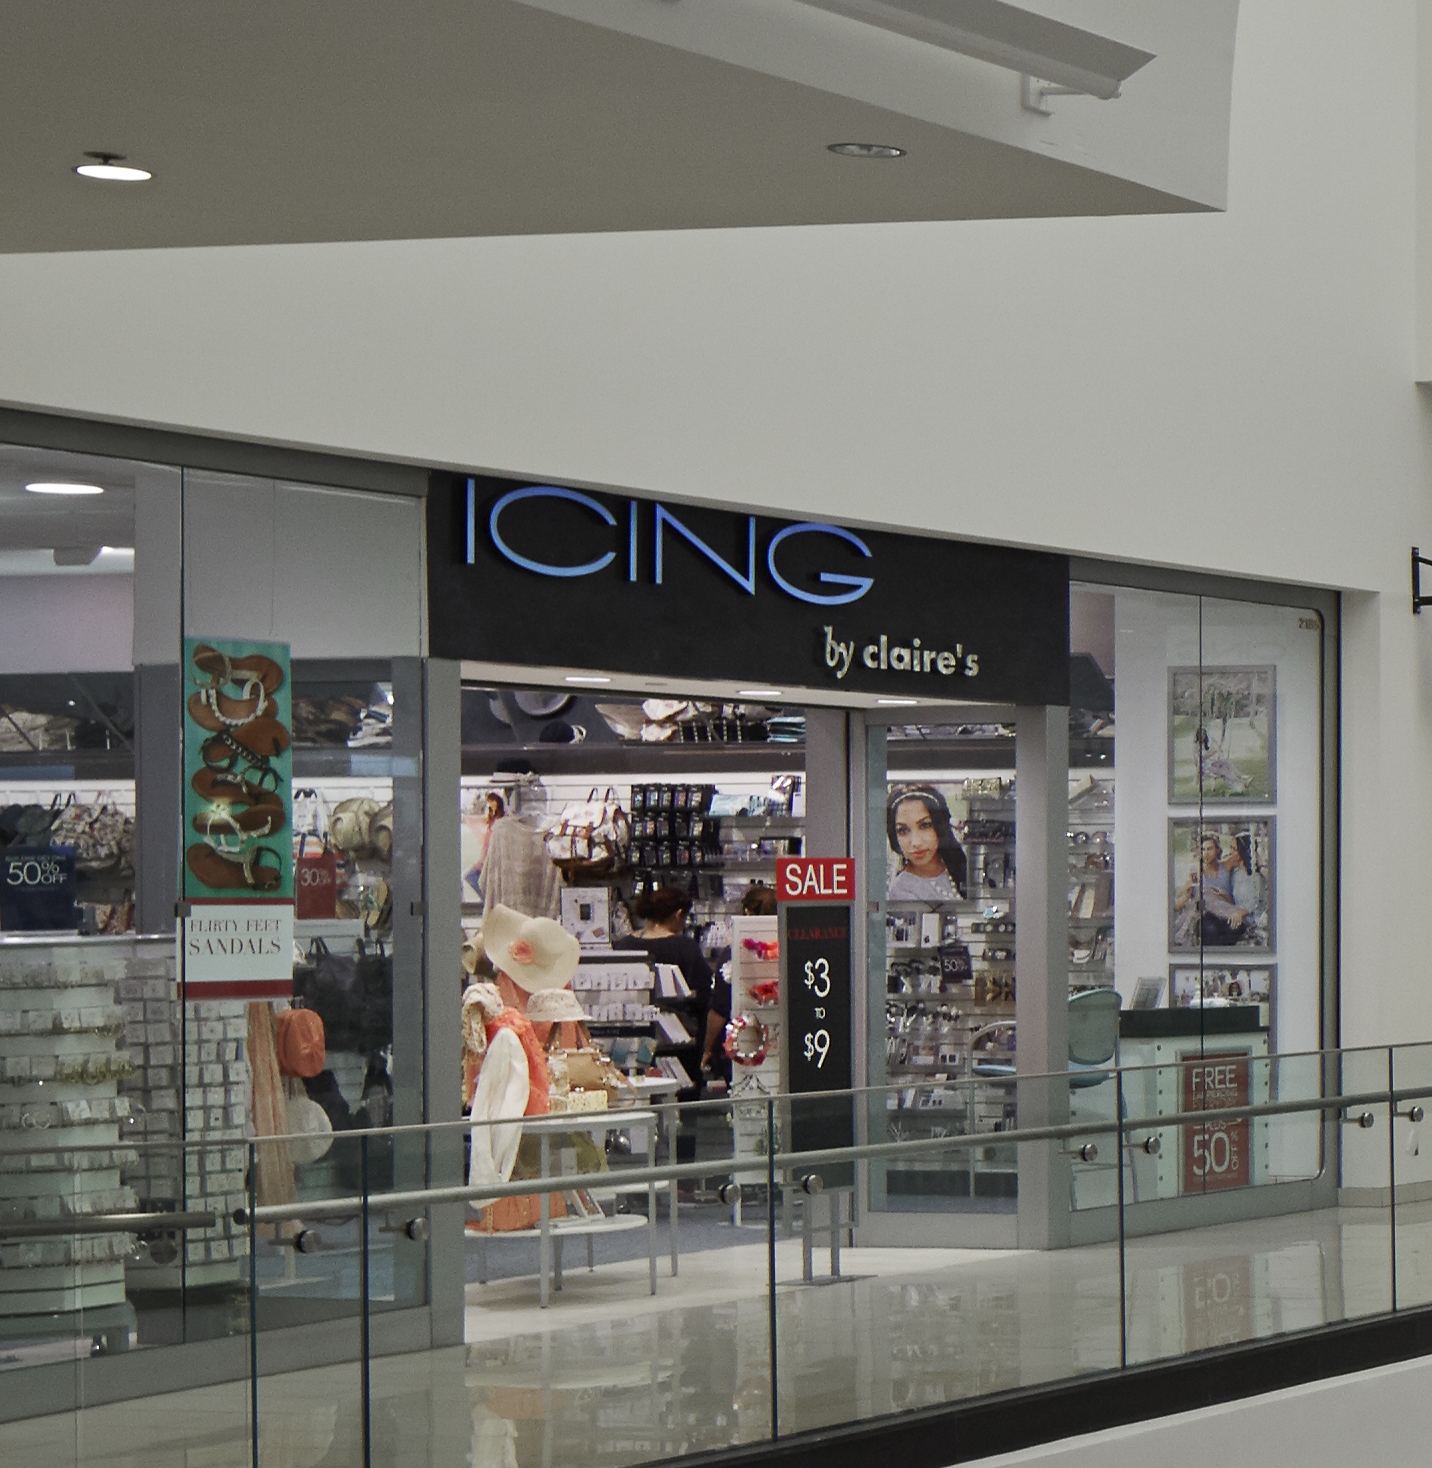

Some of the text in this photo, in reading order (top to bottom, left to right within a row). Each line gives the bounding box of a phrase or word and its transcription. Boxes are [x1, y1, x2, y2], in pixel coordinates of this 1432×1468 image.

[467, 478, 874, 606] ICING
[824, 626, 979, 679] by claire's
[785, 863, 848, 896] SALE
[190, 919, 282, 933] FLIRTY FEET
[188, 937, 282, 956] SANDALS
[803, 957, 832, 998] $3
[803, 1028, 831, 1069] $9
[1192, 1065, 1238, 1091] FREE
